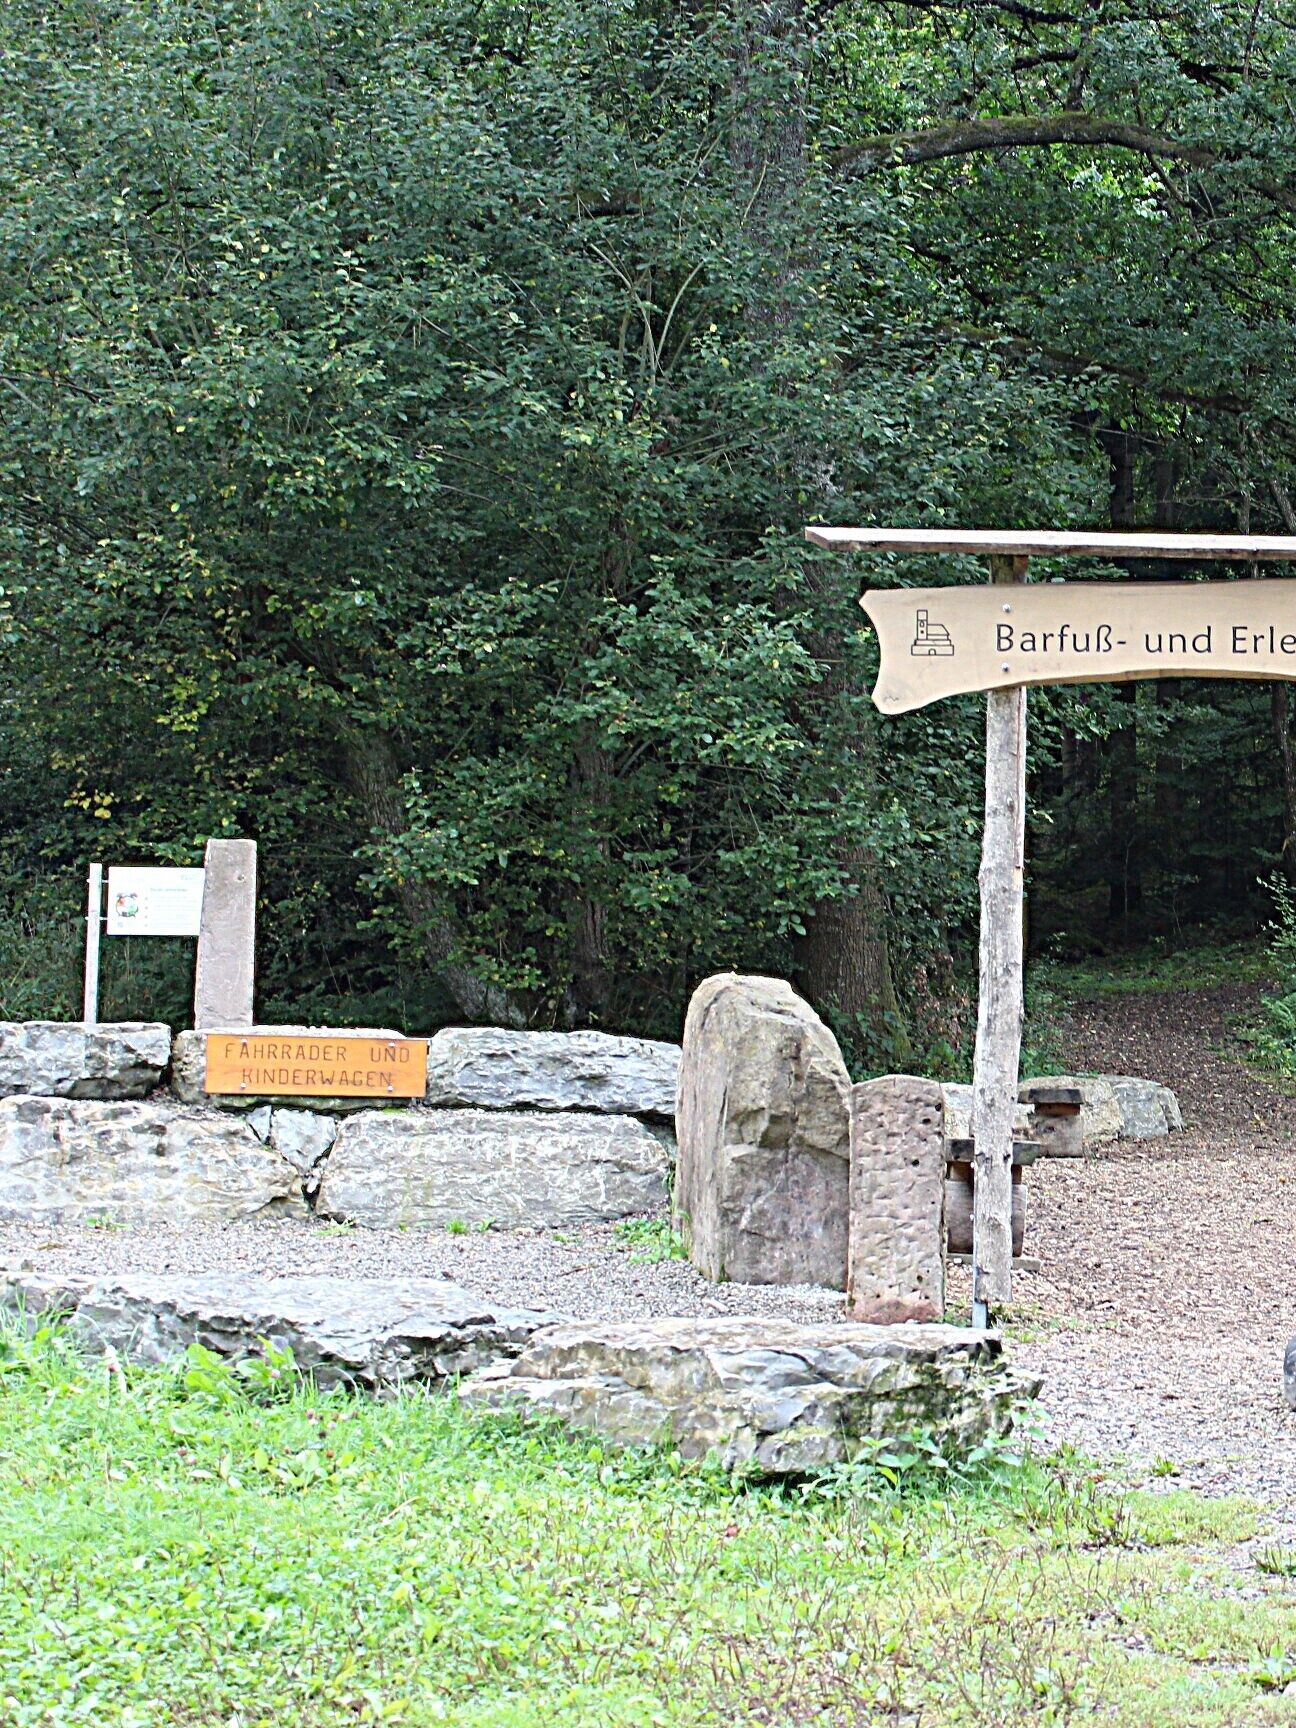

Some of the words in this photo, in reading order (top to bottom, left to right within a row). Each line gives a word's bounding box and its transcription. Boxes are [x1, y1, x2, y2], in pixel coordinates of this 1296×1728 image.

[995, 623, 1127, 653] Barfuß-
[1144, 625, 1213, 654] und
[370, 1046, 410, 1064] UND
[242, 1067, 393, 1088] KINDERWAGEN
